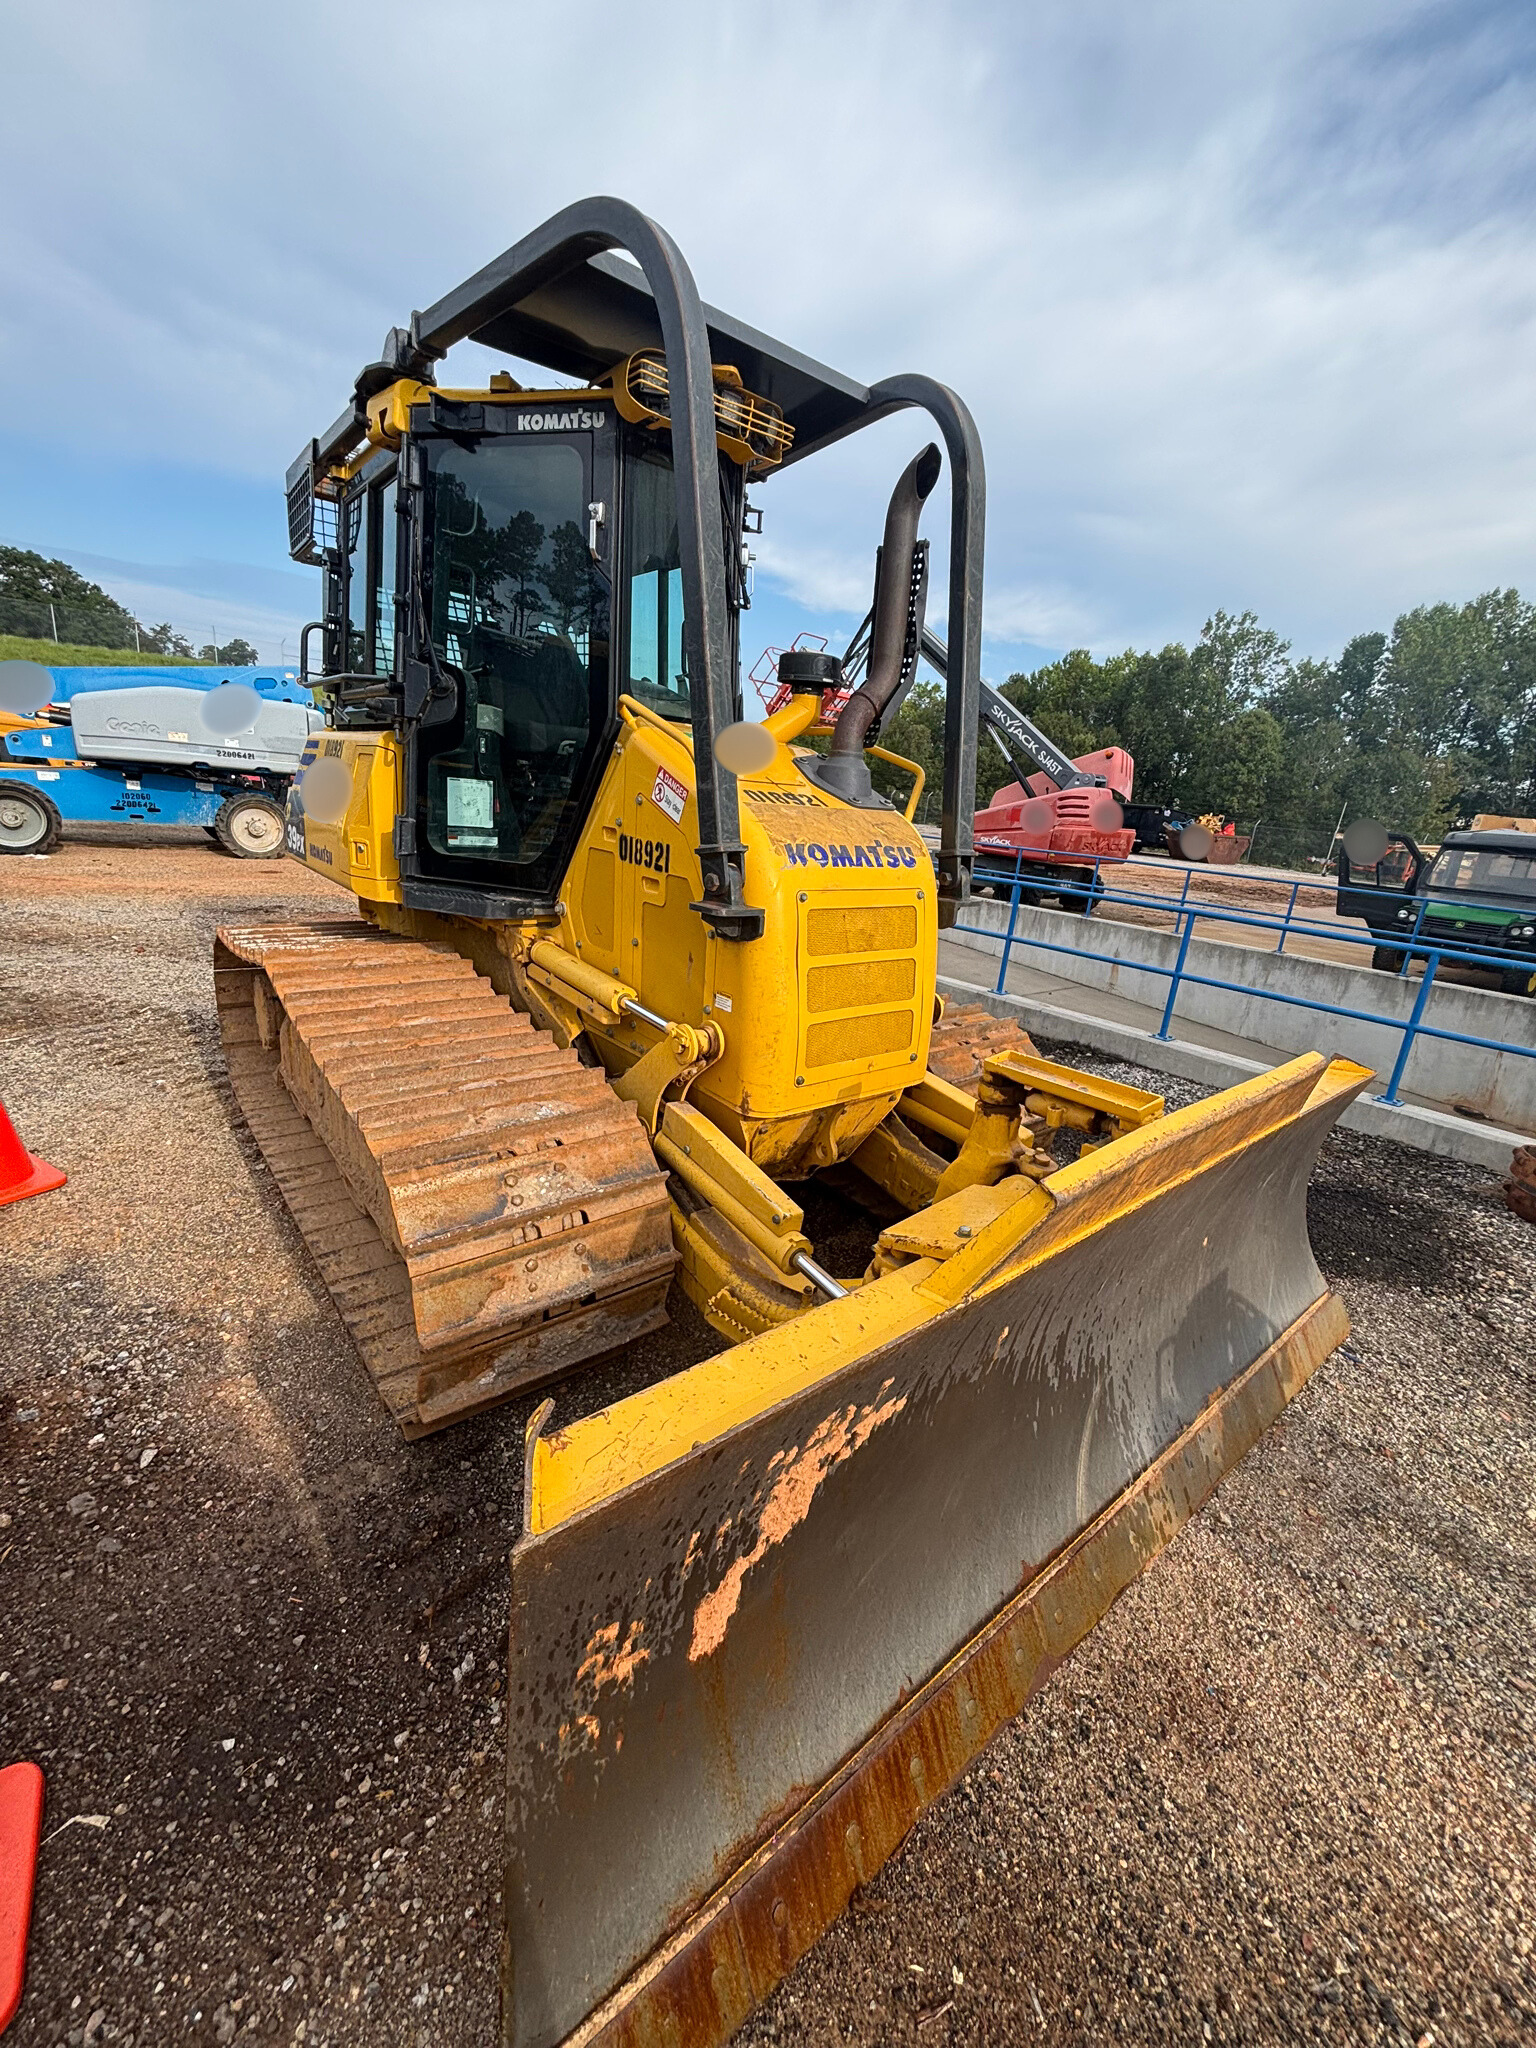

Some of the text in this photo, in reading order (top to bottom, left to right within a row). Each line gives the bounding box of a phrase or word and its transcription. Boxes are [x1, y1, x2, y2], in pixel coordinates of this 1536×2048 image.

[517, 407, 605, 431] KOMATSU
[991, 704, 1063, 776] SKYJACK SJ45T
[664, 774, 687, 800] DANGER
[743, 789, 829, 807] 018921
[619, 833, 670, 873] 018921
[784, 839, 917, 868] KOMATSU
[979, 835, 1011, 847] SKYJACK
[309, 842, 333, 866] KOMATSU
